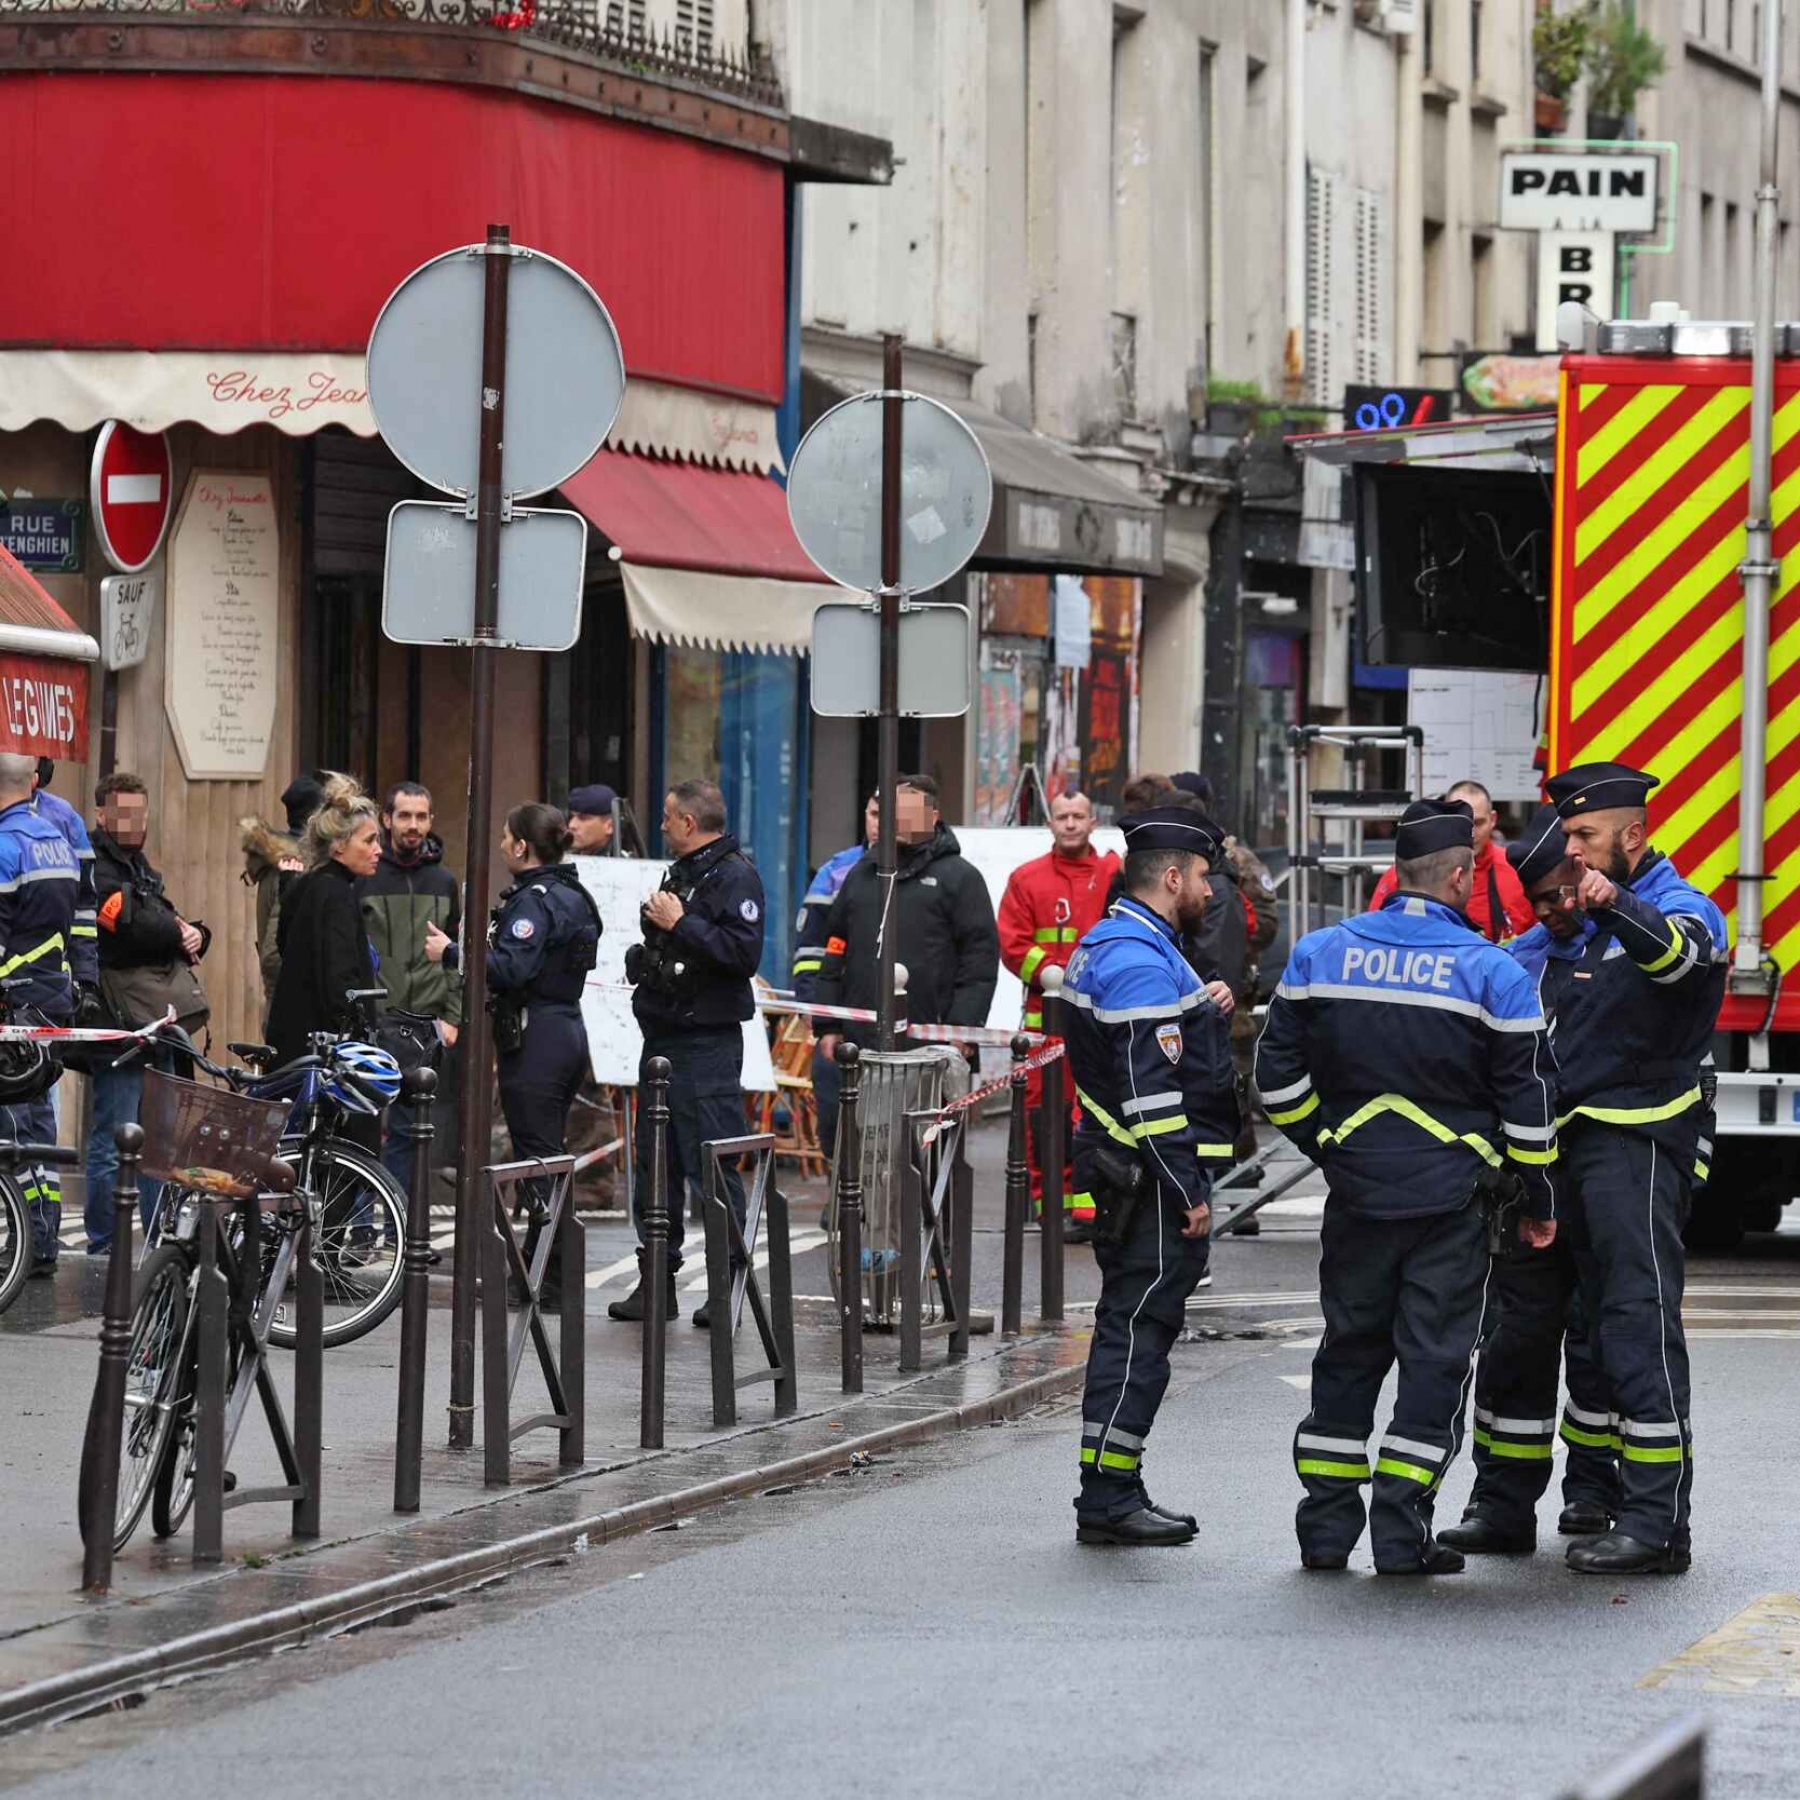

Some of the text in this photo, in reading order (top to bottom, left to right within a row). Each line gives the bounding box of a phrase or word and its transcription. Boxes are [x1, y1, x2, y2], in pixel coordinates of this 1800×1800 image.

[1511, 168, 1645, 197] PAIN
[206, 371, 368, 419] Chez Jea
[11, 515, 54, 533] RUE
[0, 535, 70, 554] 'ENGHIEN
[117, 581, 146, 605] SAUF
[1341, 946, 1456, 989] POLICE
